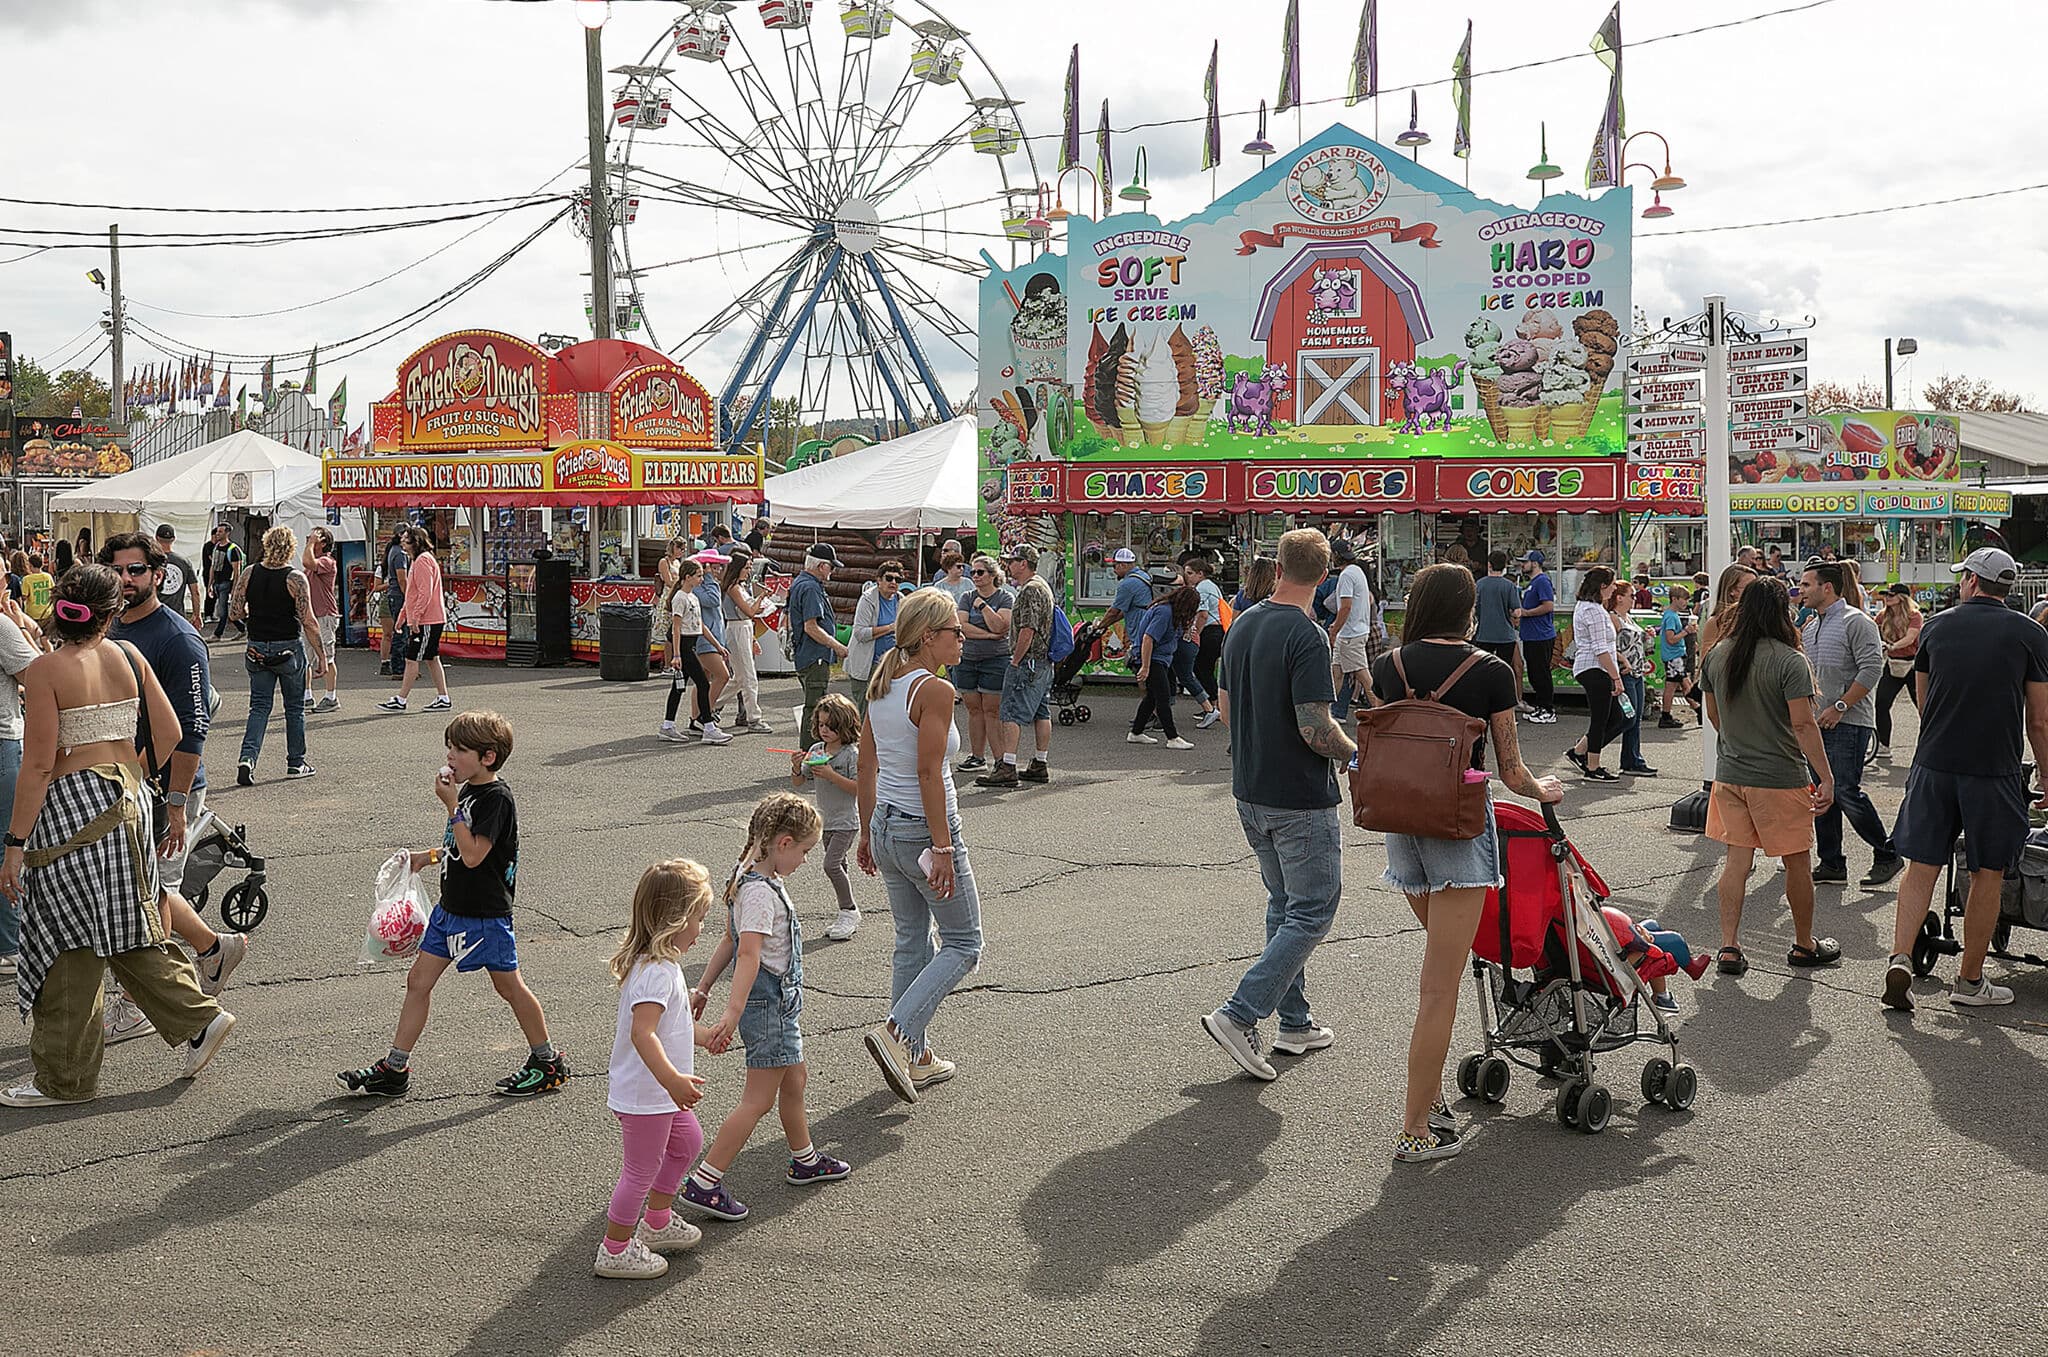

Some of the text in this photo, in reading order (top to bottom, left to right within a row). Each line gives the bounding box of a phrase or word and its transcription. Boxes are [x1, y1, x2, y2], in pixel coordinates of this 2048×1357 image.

[1291, 147, 1384, 181] POLAR BEAR
[1291, 190, 1384, 222] ICE CREAM
[1321, 228, 1355, 236] GREATEST
[1356, 226, 1368, 234] ICE
[1369, 221, 1396, 231] CREAM
[1479, 212, 1605, 240] OUTRAGEOUS
[1093, 230, 1191, 256] INCREDIBLE
[1490, 238, 1595, 273] HARD
[1098, 255, 1187, 288] SOFT
[1492, 272, 1591, 289] SCOOPED
[1114, 288, 1169, 301] SERVE
[1480, 290, 1603, 310] ICE CREAM
[1088, 304, 1196, 323] ICE CREAM
[1306, 326, 1368, 336] HOMEMADE
[1014, 336, 1040, 350] POLAR
[1301, 336, 1373, 347] FARM FRESH
[1732, 346, 1792, 362] BARN BLVD
[1737, 371, 1789, 384] CENTER
[406, 347, 455, 438] Fried
[483, 344, 540, 433] Dough
[1643, 382, 1695, 394] MEMORY
[1742, 381, 1784, 393] STAGE
[619, 377, 705, 433] Fried Dough
[1653, 392, 1685, 402] LANE
[1735, 399, 1792, 413] MOTORIZED
[426, 410, 517, 432] FRUIT & SUGAR
[1645, 415, 1695, 427] MIDWAY
[1744, 410, 1783, 421] EVENTS
[54, 422, 109, 438] Chicken
[442, 423, 500, 439] TOPPINGS
[633, 417, 692, 432] FRUIT & SUGAR
[645, 426, 682, 437] TOPPINGS
[1733, 429, 1769, 441] WHITE'S
[1770, 427, 1794, 438] GATE
[1896, 425, 1957, 449] FRIED DOUGH
[1647, 439, 1691, 451] ROLLER
[1750, 439, 1777, 449] EXIT
[1644, 449, 1694, 460] COASTER
[1827, 452, 1888, 469] SLUSHIES
[556, 445, 630, 485] Fried Dough
[644, 461, 756, 485] ELEPHANT EARS
[329, 465, 428, 489] ELEPHANT EARS
[432, 463, 542, 489] ICE COLD DRINKS
[1086, 471, 1206, 498] SHAKES
[1255, 470, 1405, 497] SUNDAES
[1468, 469, 1582, 496] CONES
[1631, 481, 1661, 496] ICE
[1731, 495, 1856, 512] DEEP FRIED OREO'S
[1869, 494, 1945, 511] COLD DRINKS
[1953, 493, 2009, 513] FRIED DOUGH
[34, 589, 49, 606] 10
[188, 662, 205, 716] vineyard
